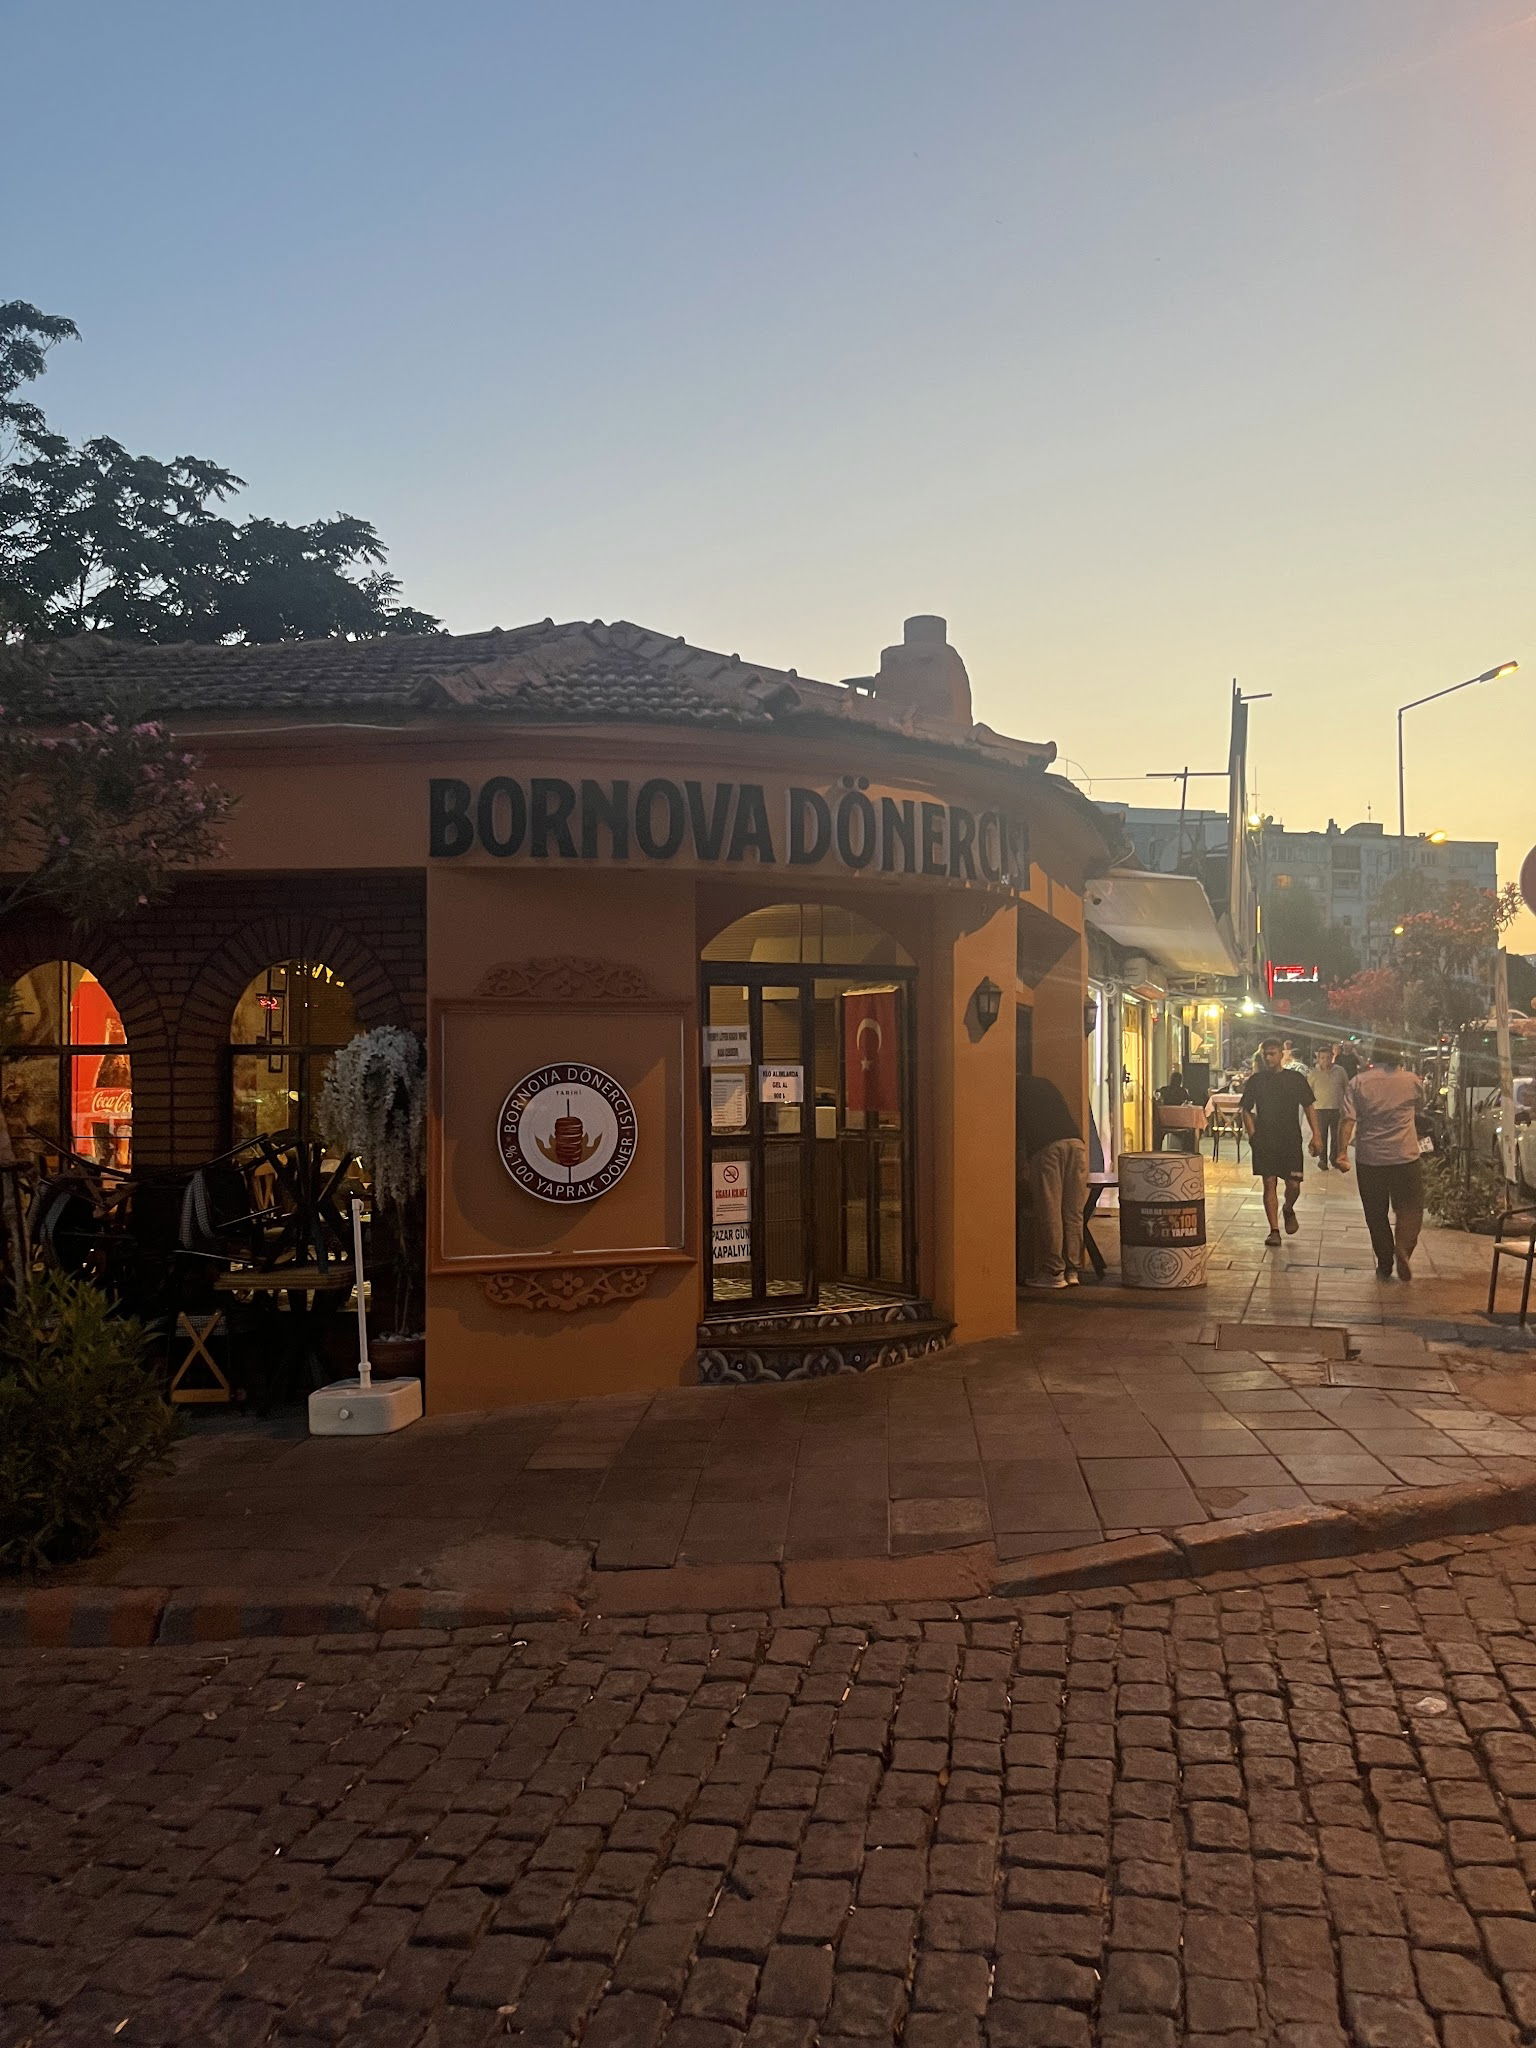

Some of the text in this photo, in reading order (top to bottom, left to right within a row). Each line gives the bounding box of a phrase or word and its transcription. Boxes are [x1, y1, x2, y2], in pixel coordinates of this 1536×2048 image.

[429, 777, 776, 864] BORNOVA
[92, 1091, 132, 1113] Coca-Co
[504, 1067, 635, 1133] BORNOVA DÖNERCİSİ
[536, 1178, 598, 1198] YAPRAK
[600, 1136, 634, 1186] DÖNER
